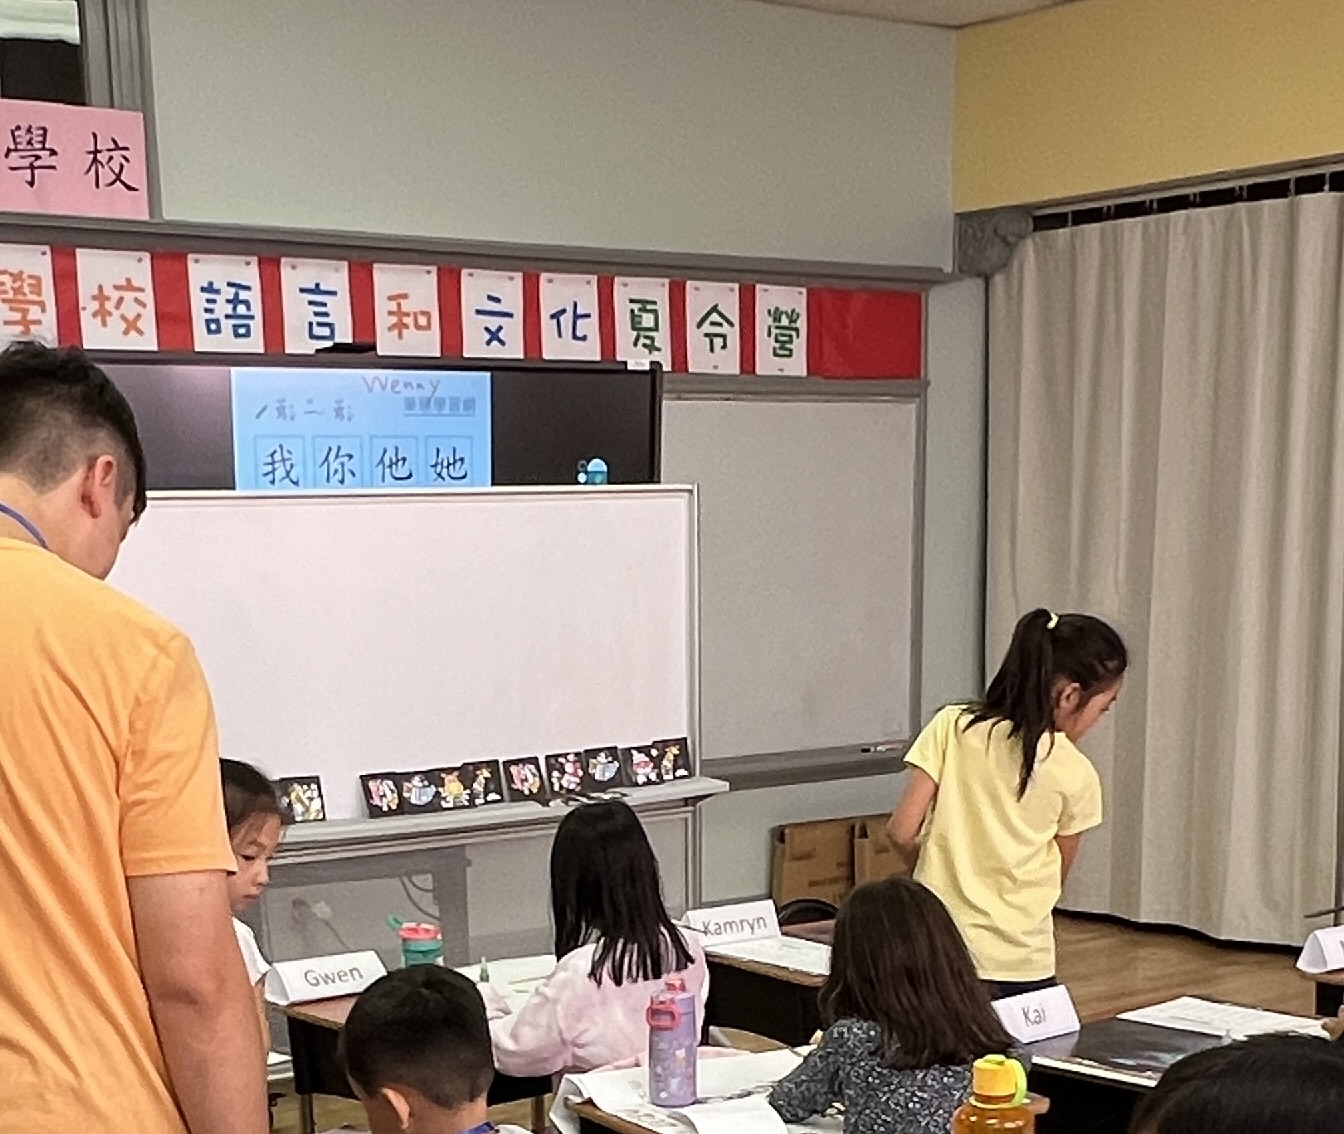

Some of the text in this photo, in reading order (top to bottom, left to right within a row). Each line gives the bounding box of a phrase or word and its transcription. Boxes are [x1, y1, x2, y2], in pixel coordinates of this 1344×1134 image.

[262, 443, 469, 487] 我你他她
[701, 915, 769, 938] Kamryn
[303, 966, 364, 988] Gwen
[1021, 1002, 1048, 1028] Kai
